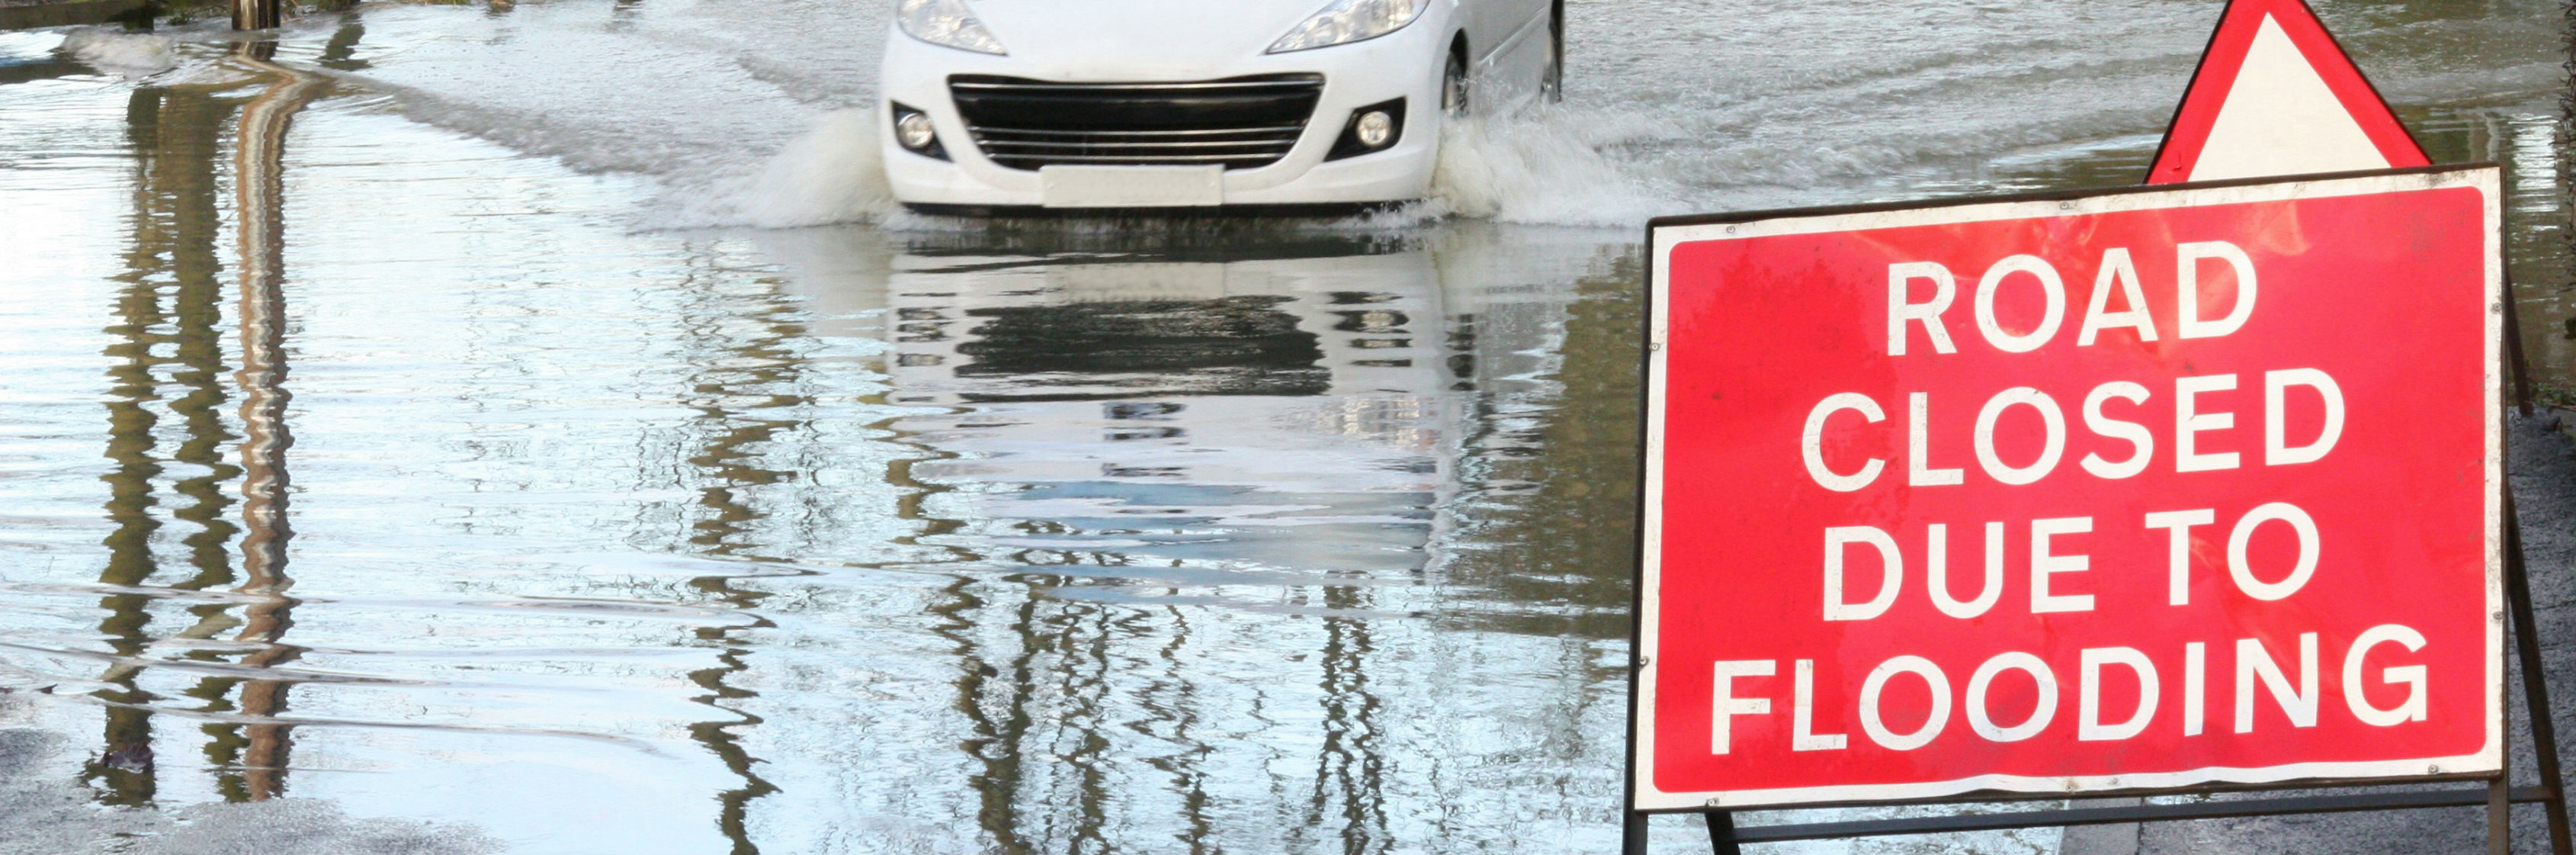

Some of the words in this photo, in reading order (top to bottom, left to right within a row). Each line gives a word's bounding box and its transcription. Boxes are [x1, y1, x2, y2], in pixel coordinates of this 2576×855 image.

[1887, 240, 2257, 356] ROAD
[1801, 367, 2346, 492] CLOSED
[1824, 516, 2095, 621] DUE
[2145, 502, 2320, 606] TO
[1711, 624, 2428, 754] FLOODING
